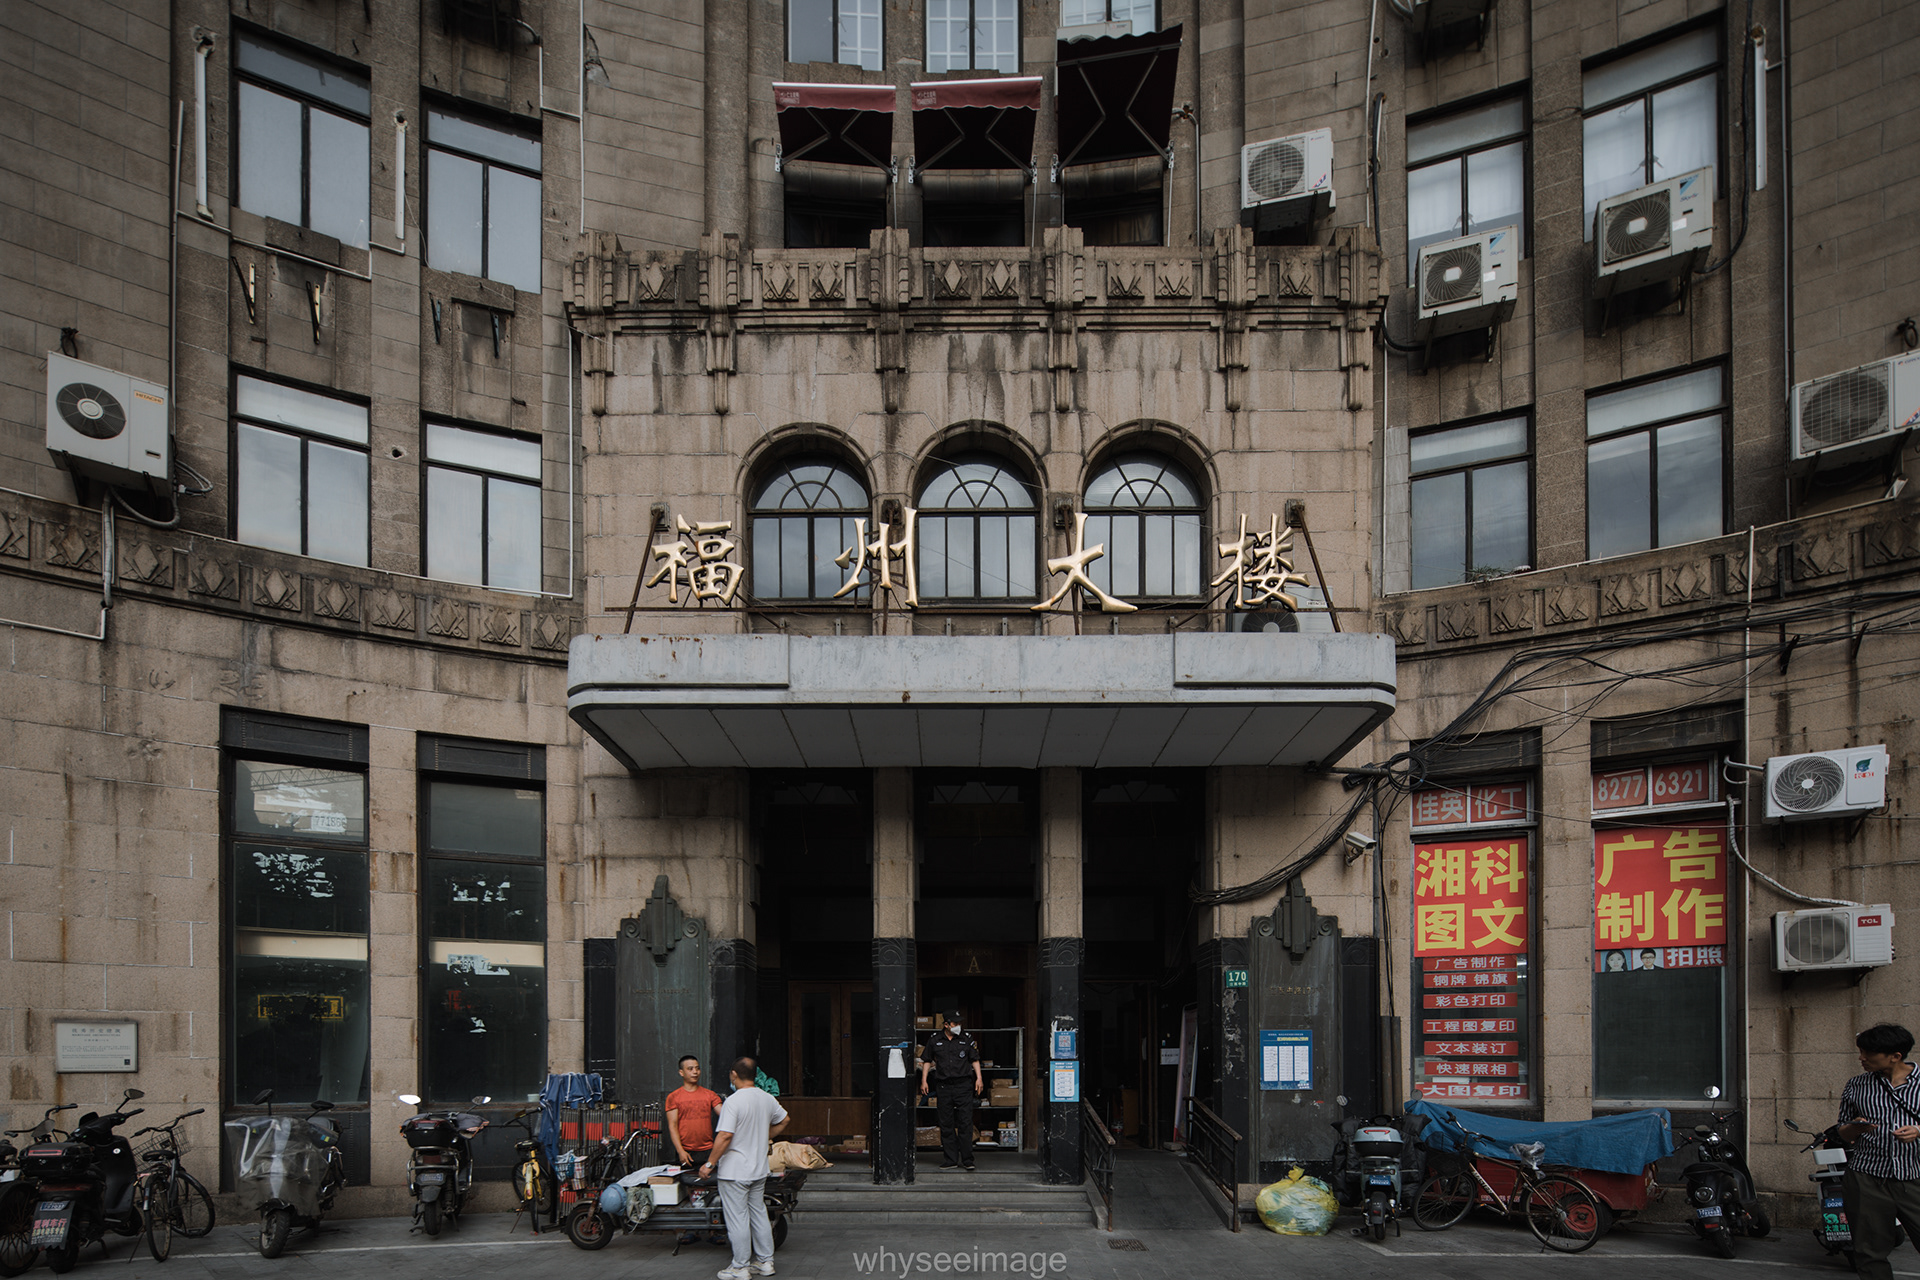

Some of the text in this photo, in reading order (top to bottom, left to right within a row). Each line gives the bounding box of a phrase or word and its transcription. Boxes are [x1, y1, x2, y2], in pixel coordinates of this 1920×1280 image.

[135, 392, 162, 403] HITACHI
[646, 506, 1309, 613] 福州大楼
[1598, 769, 1703, 802] 8277 6321
[1416, 788, 1523, 823] 佳英化工
[1597, 828, 1722, 888] 广告
[1416, 843, 1525, 897] 湘科
[1597, 887, 1724, 943] 制作
[1417, 898, 1525, 951] 图文
[1434, 956, 1506, 970] 广告制作
[1666, 946, 1724, 967] 拍照
[967, 956, 983, 974] A
[1228, 971, 1247, 982] 170
[1433, 973, 1508, 986] 铜牌 锦旗
[1435, 994, 1506, 1007] 彩色打印
[1426, 1020, 1515, 1032] 工程图复印
[1435, 1042, 1507, 1054] 文本装订
[1436, 1063, 1507, 1075] 快速照相
[1423, 1084, 1521, 1097] 大图复印
